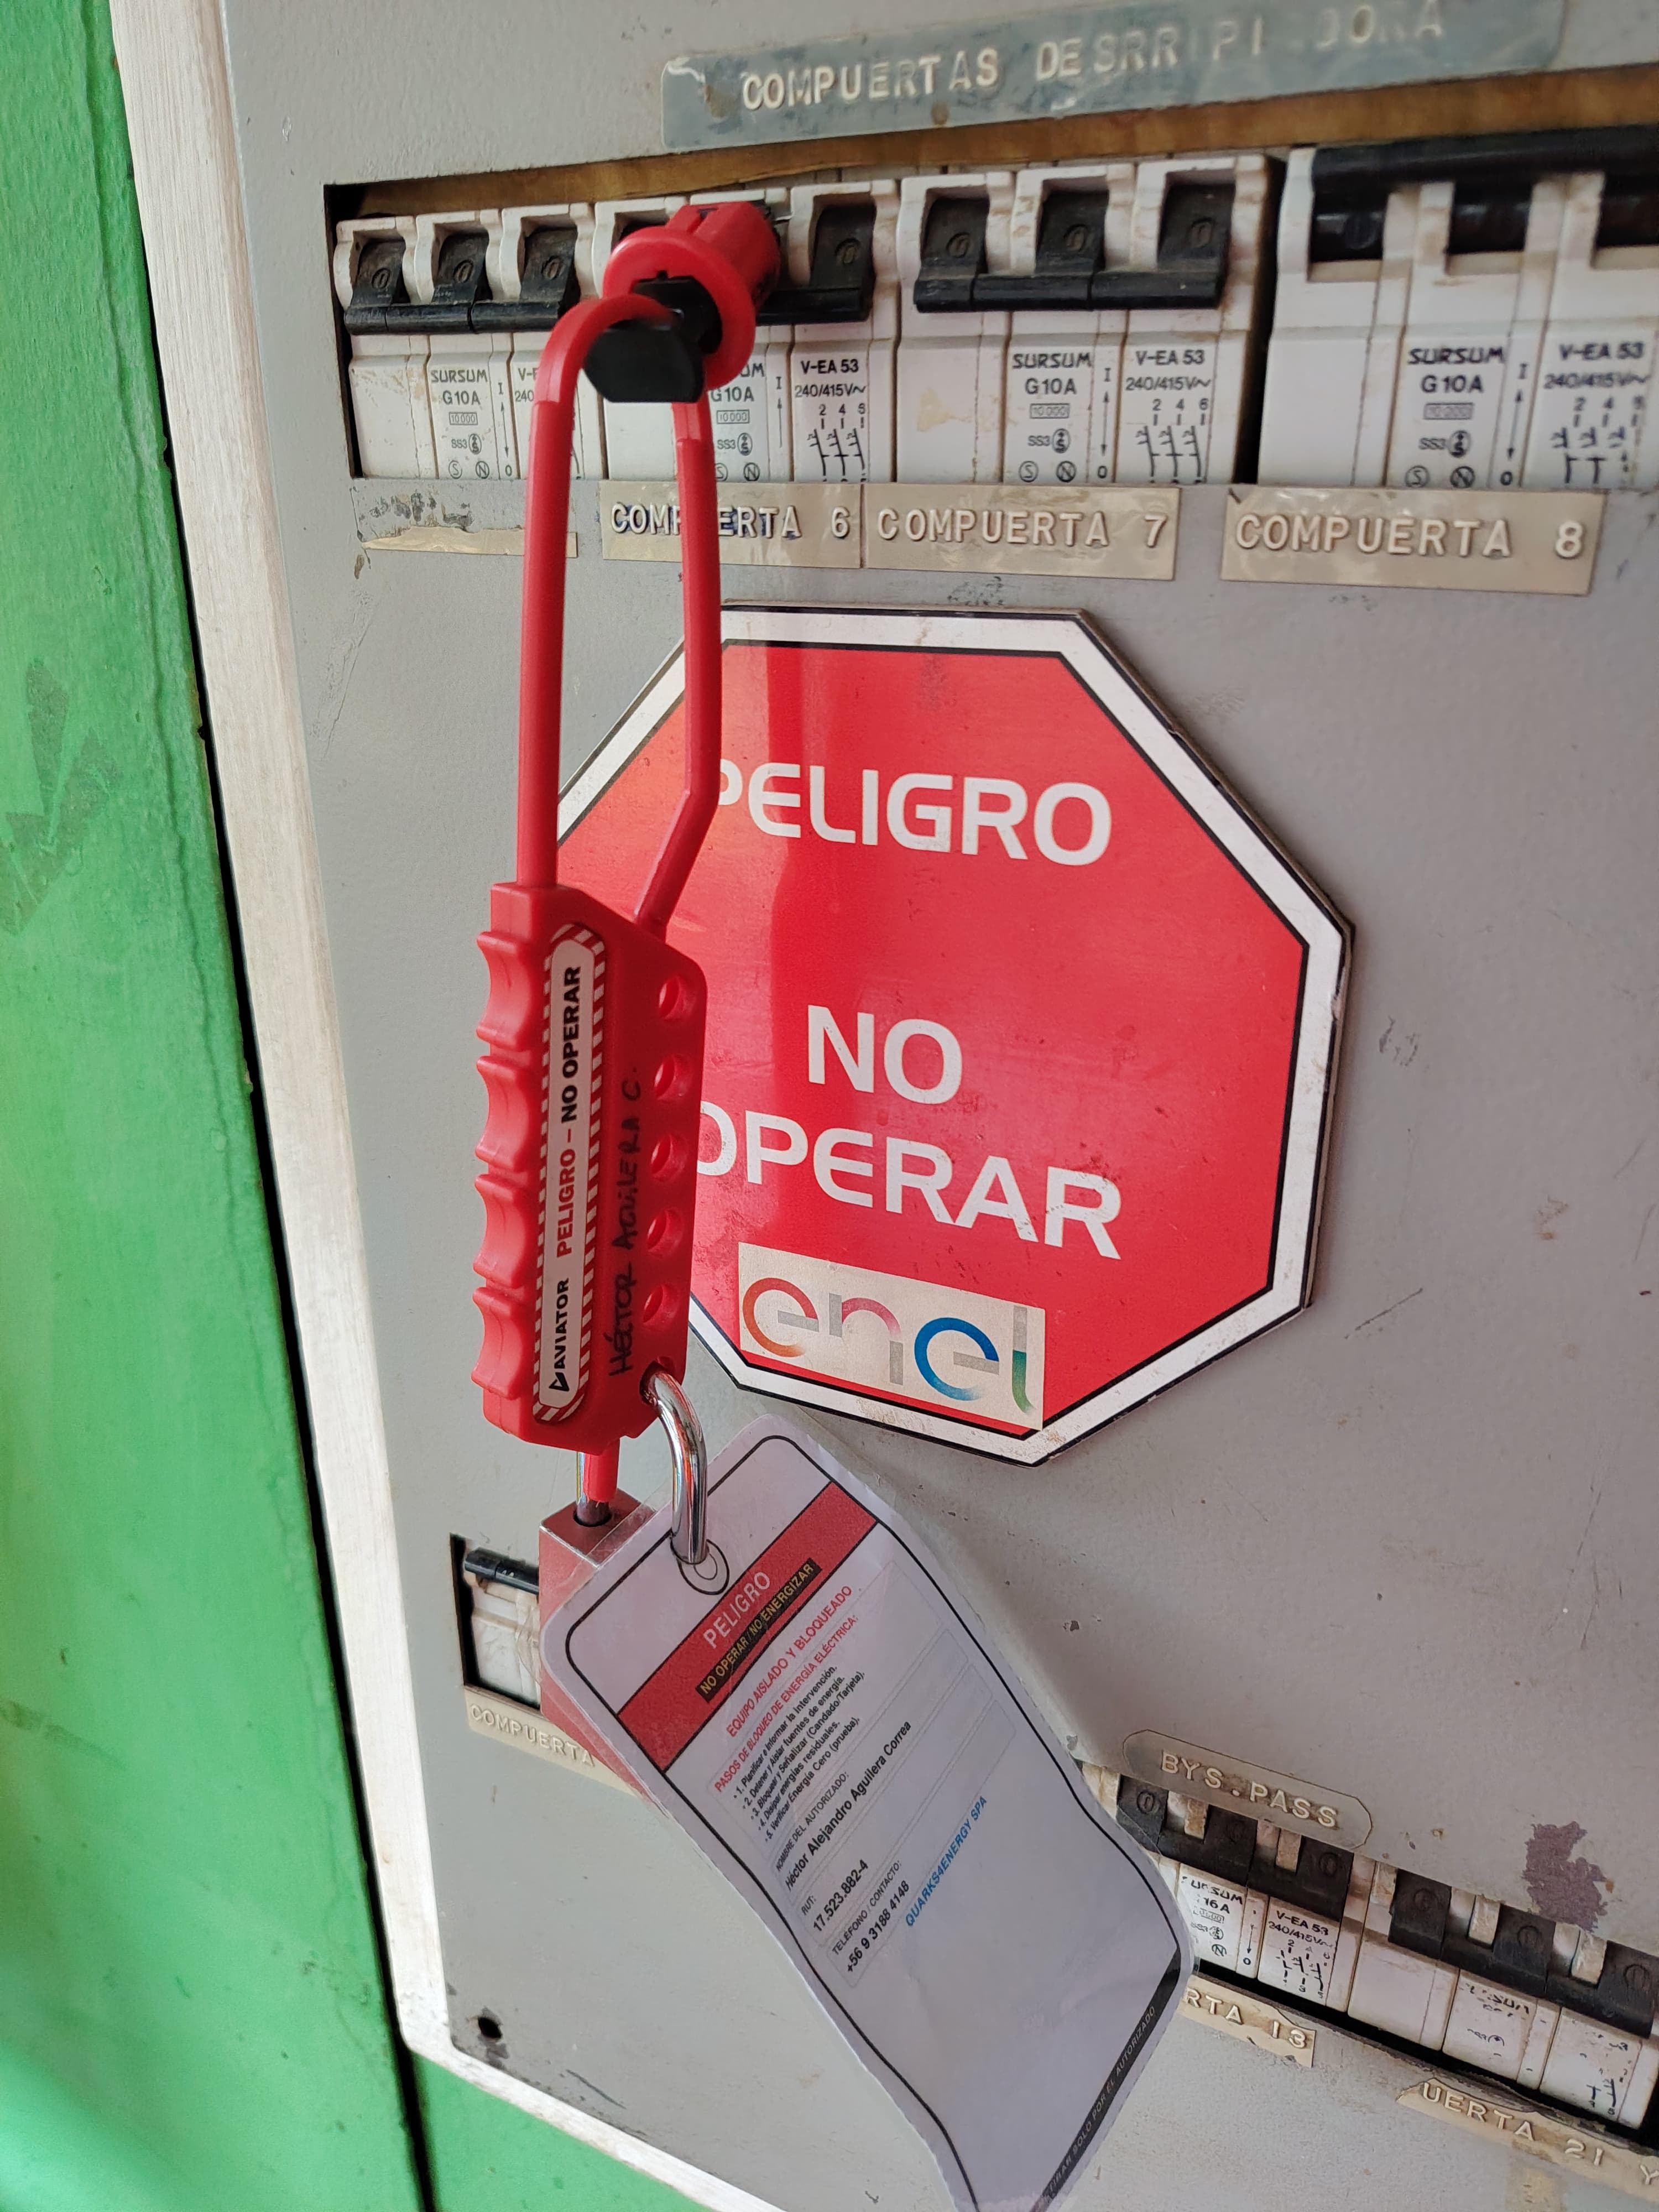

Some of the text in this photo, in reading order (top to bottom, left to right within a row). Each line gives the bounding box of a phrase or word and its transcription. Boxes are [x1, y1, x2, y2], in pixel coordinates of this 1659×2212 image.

[742, 47, 999, 111] COMPUERTAS
[431, 369, 488, 383] SURSUM
[801, 359, 859, 374] V-EA 53
[1013, 352, 1093, 370] SURSUM
[1025, 378, 1077, 396] G10A
[1135, 349, 1205, 366] V-EA 53
[1407, 346, 1505, 365] SURSUM
[442, 390, 481, 405] G10A
[711, 387, 754, 402] G10A
[820, 404, 826, 415] 2
[839, 404, 846, 415] 4
[1153, 399, 1208, 410] 2 4 6
[717, 440, 735, 450] SS3
[611, 502, 851, 540] COMERTA 6
[877, 508, 1167, 549] COMPUERTA 7
[1236, 513, 1583, 559] COMPUERTA 8
[562, 966, 581, 1078] OPERAR
[807, 1004, 963, 1105] NO
[561, 1084, 578, 1124] NO
[557, 1149, 576, 1258] PELIGRO
[555, 1277, 569, 1369] AVIATOR
[743, 1277, 1039, 1415] enel
[700, 1676, 717, 1695] NO
[716, 1637, 749, 1677] OPERAR
[749, 1619, 763, 1635] NO
[762, 1563, 814, 1621] ENERGIZAR
[703, 1572, 771, 1649] PELIGRO
[726, 1585, 852, 1738] EQUIPO AISLADO Y BLOQUEADO
[470, 1703, 595, 1767] COMPUERTA
[714, 1614, 859, 1792] PASOS DE BLOQUEO DE ENERGÍA ELÉCTRICA:
[779, 1738, 808, 1774] Señalizar
[806, 1671, 865, 1741] (Candado/Tarjeta).
[742, 1754, 765, 1788] Planificar
[786, 1713, 796, 1723] la
[749, 1771, 769, 1801] Detener
[767, 1764, 773, 1775] y
[771, 1746, 785, 1770] Aislar
[784, 1718, 811, 1746] fuentes
[809, 1706, 819, 1717] de
[817, 1677, 846, 1708] energía.
[764, 1788, 781, 1819] Disipar
[804, 1721, 840, 1763] residuales.
[770, 1798, 790, 1831] Verificar
[789, 1772, 815, 1802] Energía
[813, 1749, 831, 1771] Cero
[831, 1717, 860, 1752] (prueba).
[785, 1720, 912, 1891] Héctor Alejandro Aguilera Correa
[775, 1772, 849, 1872] NOMBRE DEL AUTORIZADO:
[813, 1859, 869, 1932] 17.523.882-4
[905, 1796, 987, 1927] QUARKS4ENERGY SPA
[801, 1895, 817, 1916] RUT:
[832, 1910, 869, 1955] TELÉFONO
[869, 1860, 902, 1908] CONTACTO:
[847, 1880, 910, 1973] +56 9 3188 4148
[1276, 1910, 1308, 1929] V-EA
[1092, 2092, 1107, 2121] POR
[1115, 2005, 1156, 2077] AUTORIZADO
[1272, 2020, 1307, 2049] 13
[1565, 2138, 1605, 2167] 21
